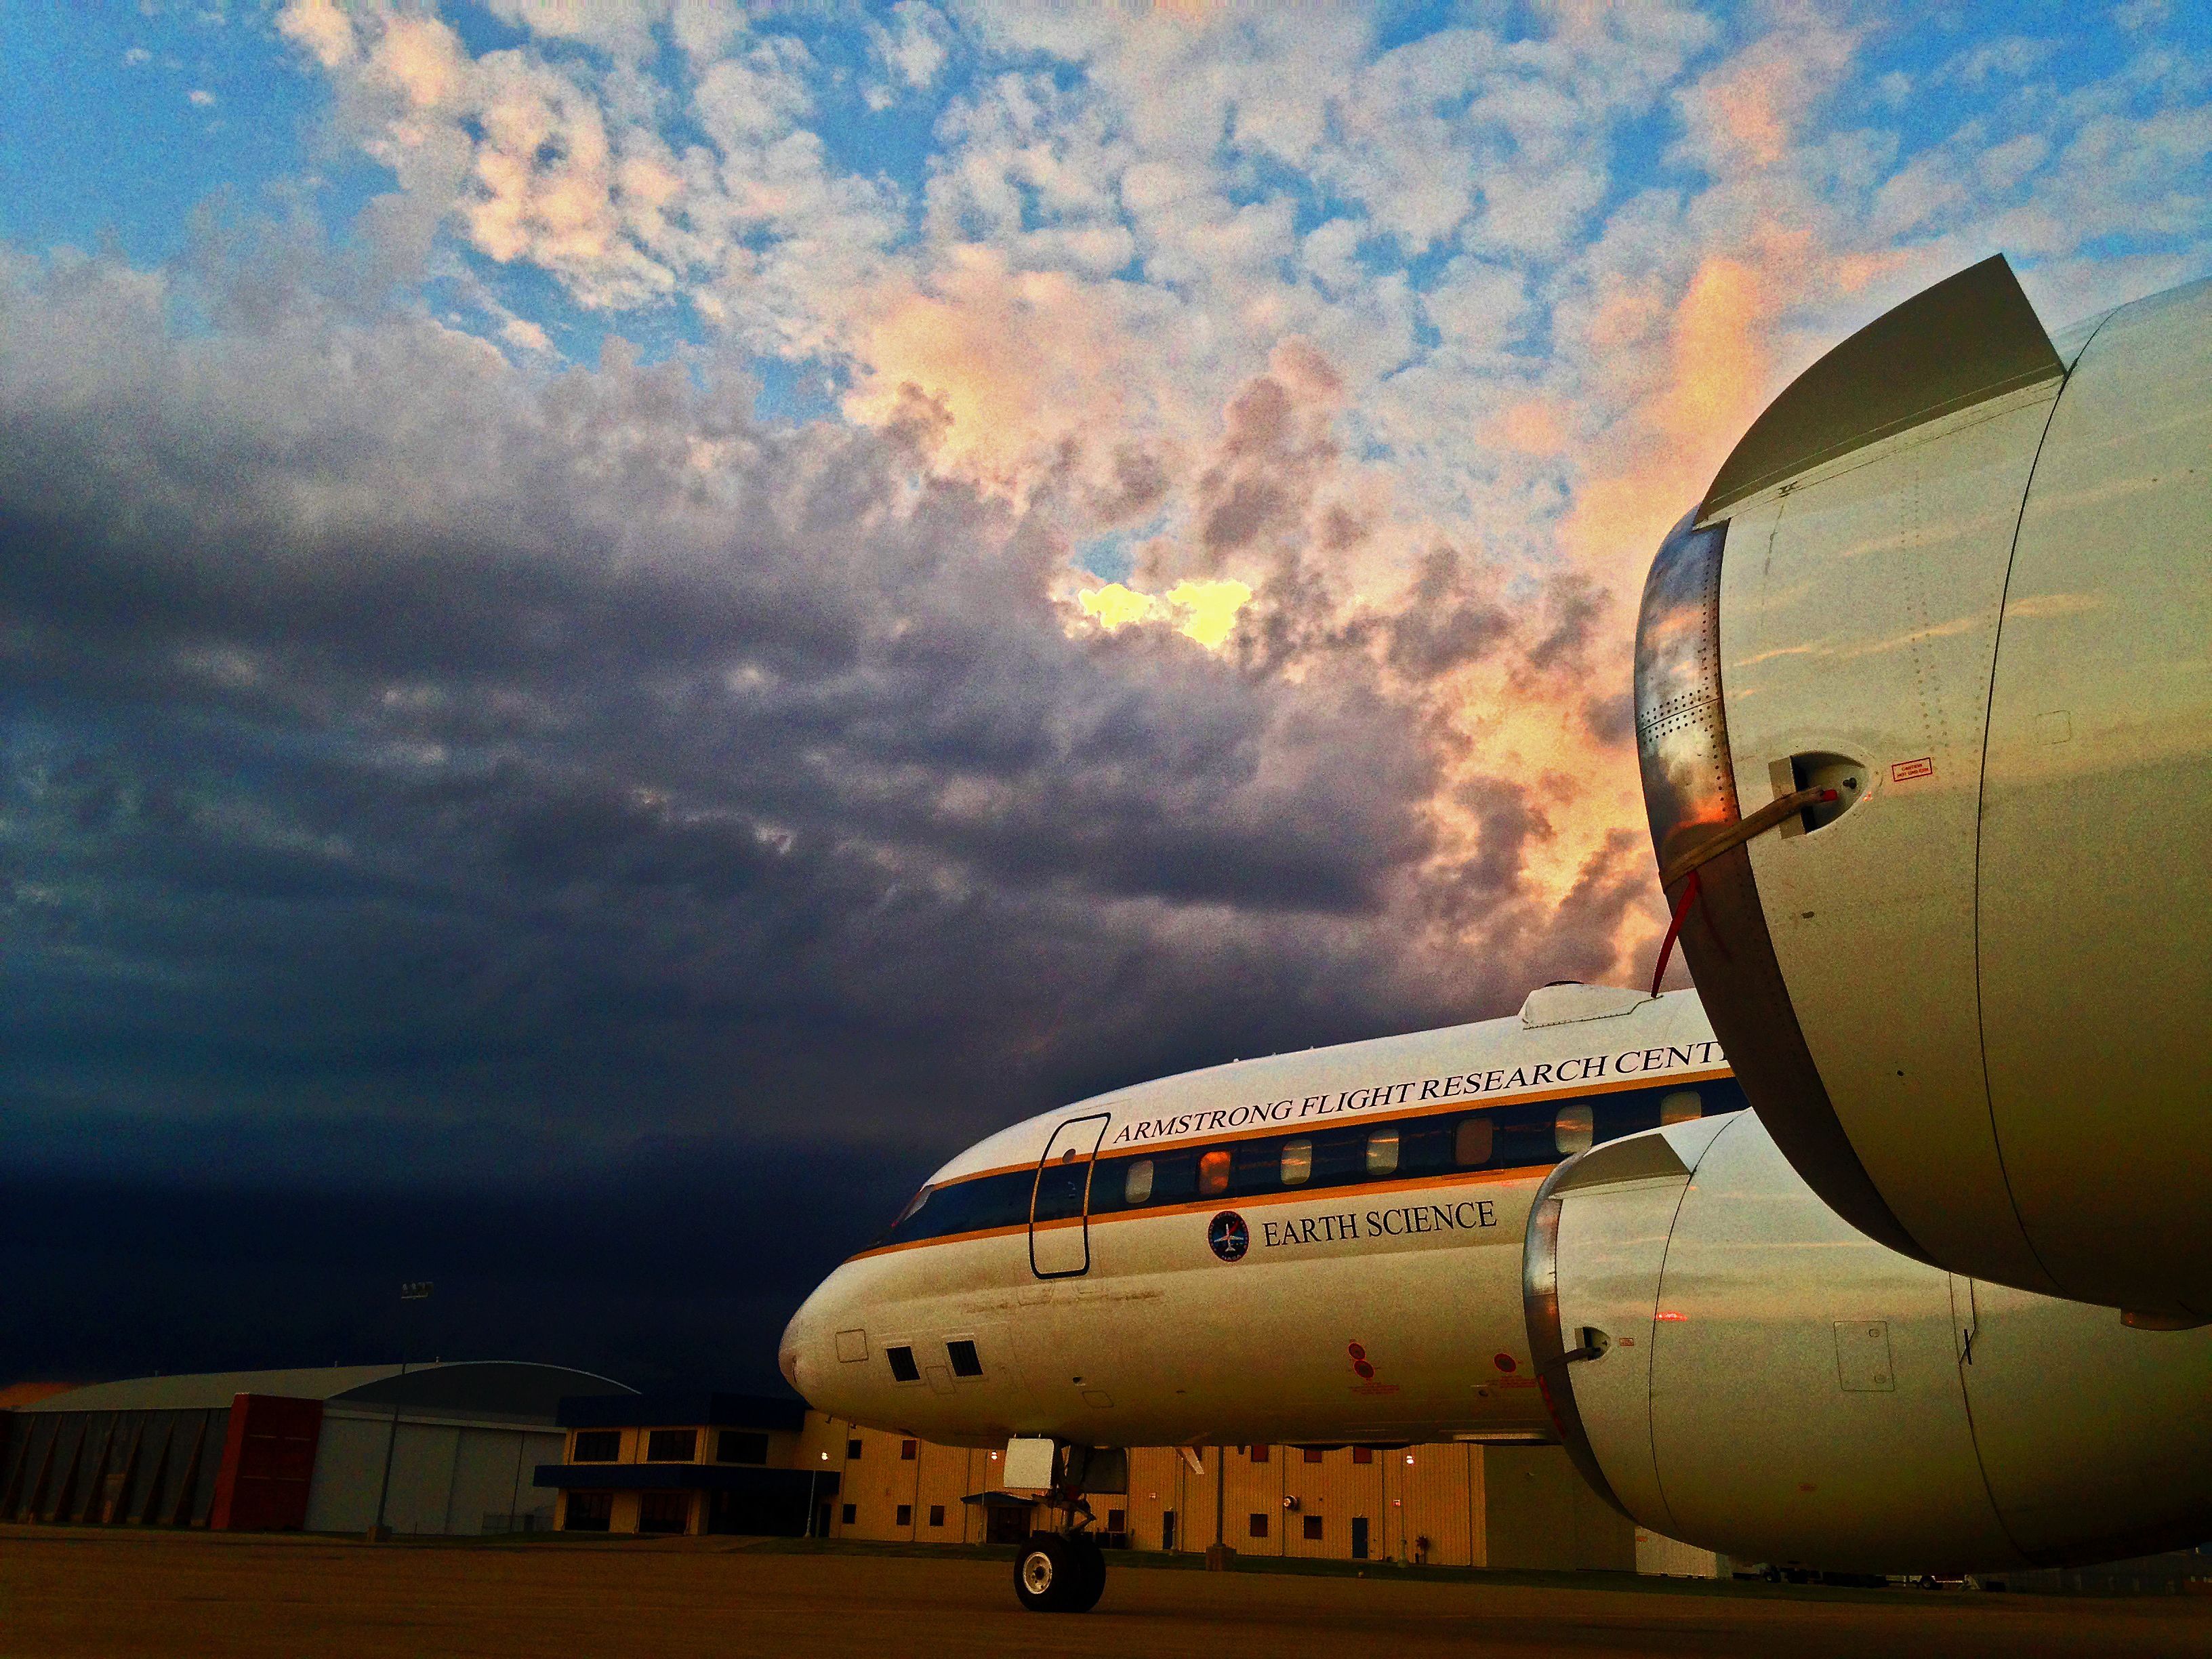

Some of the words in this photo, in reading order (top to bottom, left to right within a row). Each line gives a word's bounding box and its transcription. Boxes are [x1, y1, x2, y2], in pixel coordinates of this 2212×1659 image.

[1113, 1099, 1293, 1143] ARMSTRONG
[1298, 1082, 1415, 1117] FLIGHT
[1418, 1055, 1609, 1100] RESEARCH
[1615, 1041, 1727, 1073] CENT
[1262, 1213, 1359, 1247] EARTH
[1365, 1200, 1498, 1237] SCIENCE
